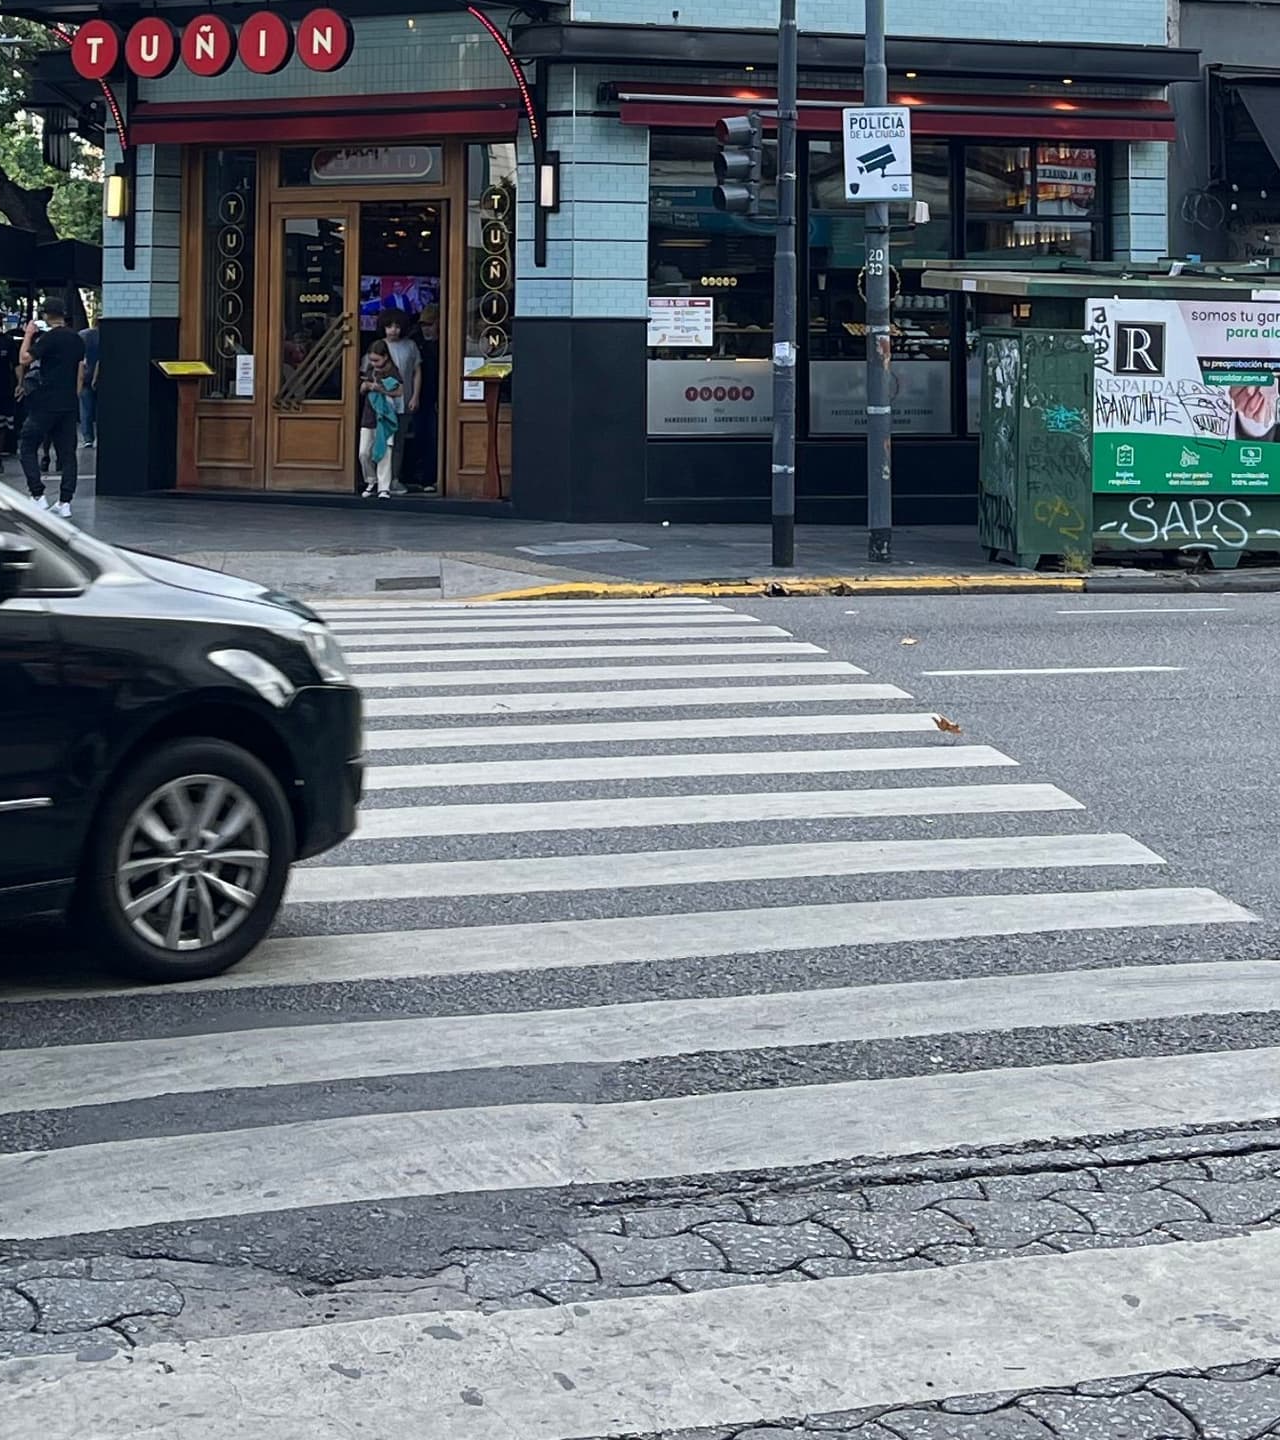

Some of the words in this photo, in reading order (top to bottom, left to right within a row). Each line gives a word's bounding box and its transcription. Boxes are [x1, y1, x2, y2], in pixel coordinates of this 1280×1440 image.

[82, 20, 336, 68] TUÑIN
[850, 116, 905, 130] POLICIA
[850, 131, 861, 139] DE
[863, 131, 873, 139] LA
[875, 130, 905, 138] CIUDAD
[1191, 311, 1237, 322] somos
[1241, 311, 1254, 322] tu
[1226, 327, 1258, 341] para
[1121, 326, 1159, 371] R
[1095, 378, 1186, 396] RESPALDAR
